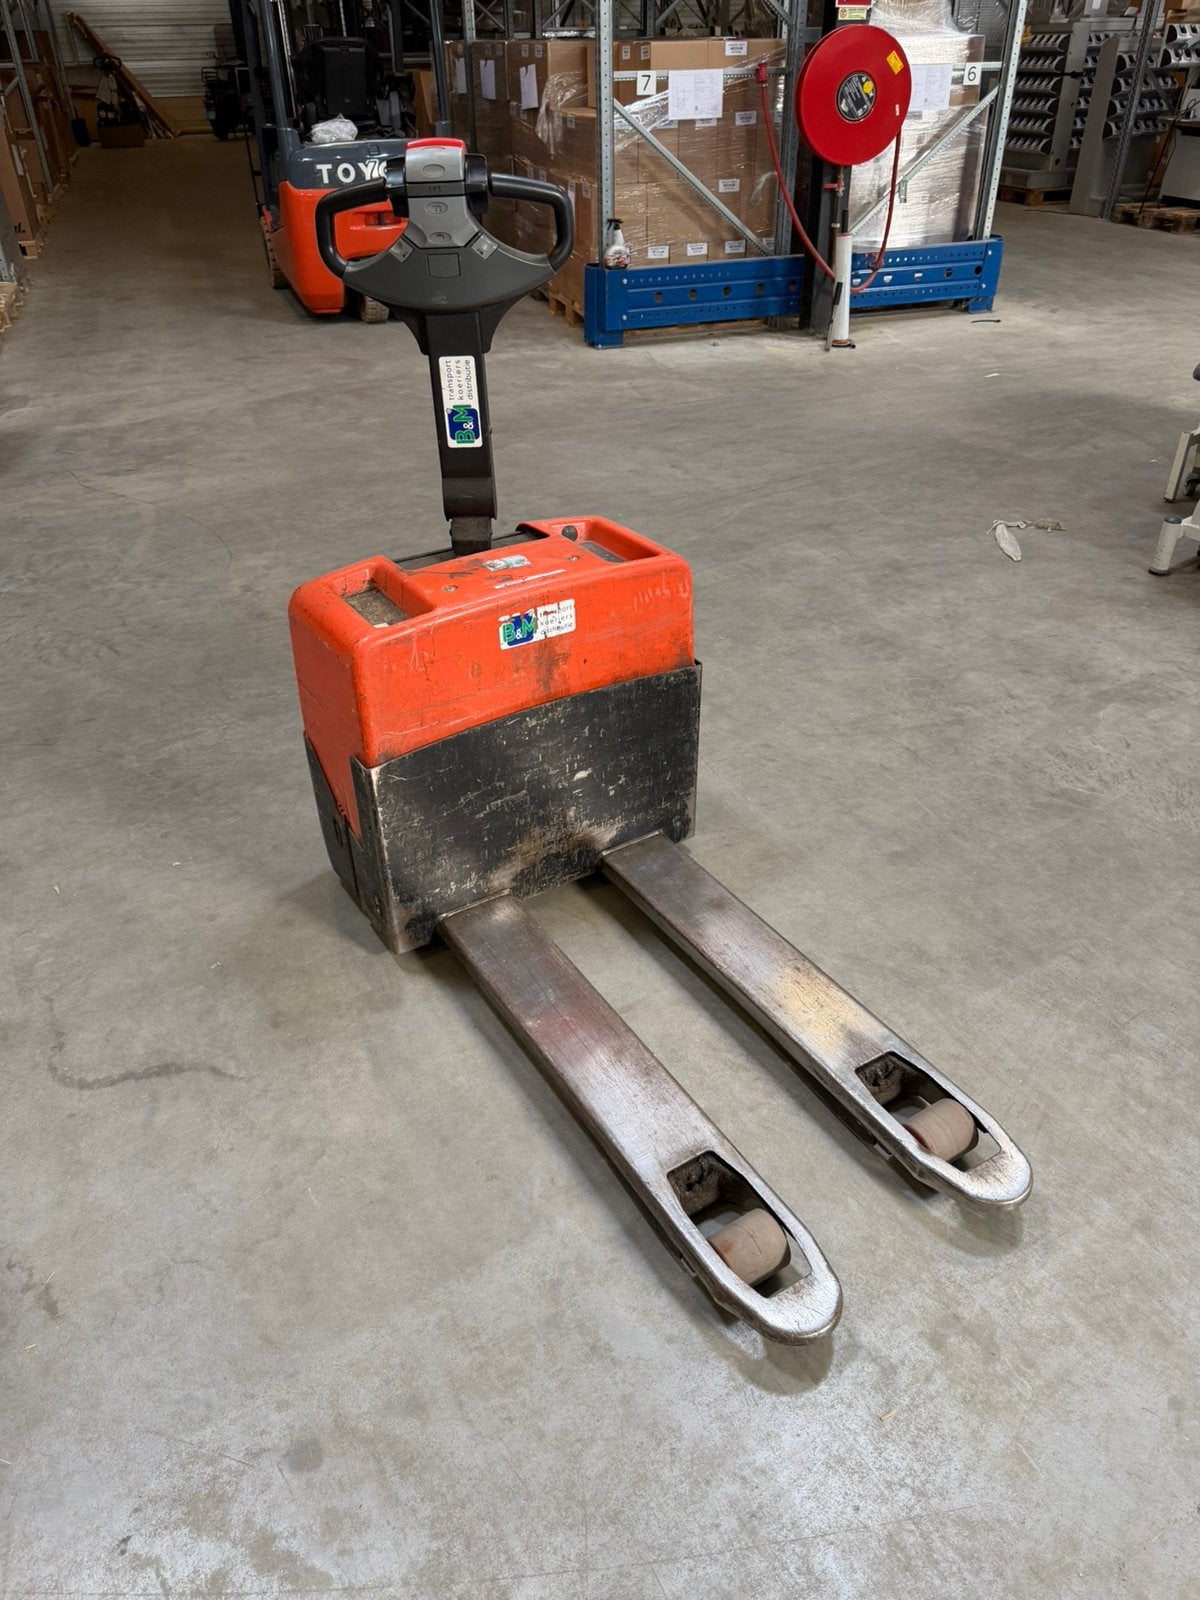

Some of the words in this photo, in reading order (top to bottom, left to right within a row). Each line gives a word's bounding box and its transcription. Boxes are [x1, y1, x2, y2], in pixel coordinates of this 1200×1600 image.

[641, 74, 652, 92] 7
[967, 65, 977, 83] 6
[445, 359, 455, 401] transport
[454, 359, 464, 401] koeriers
[464, 359, 474, 401] distributie
[452, 404, 476, 444] B&M
[502, 616, 538, 643] B&M
